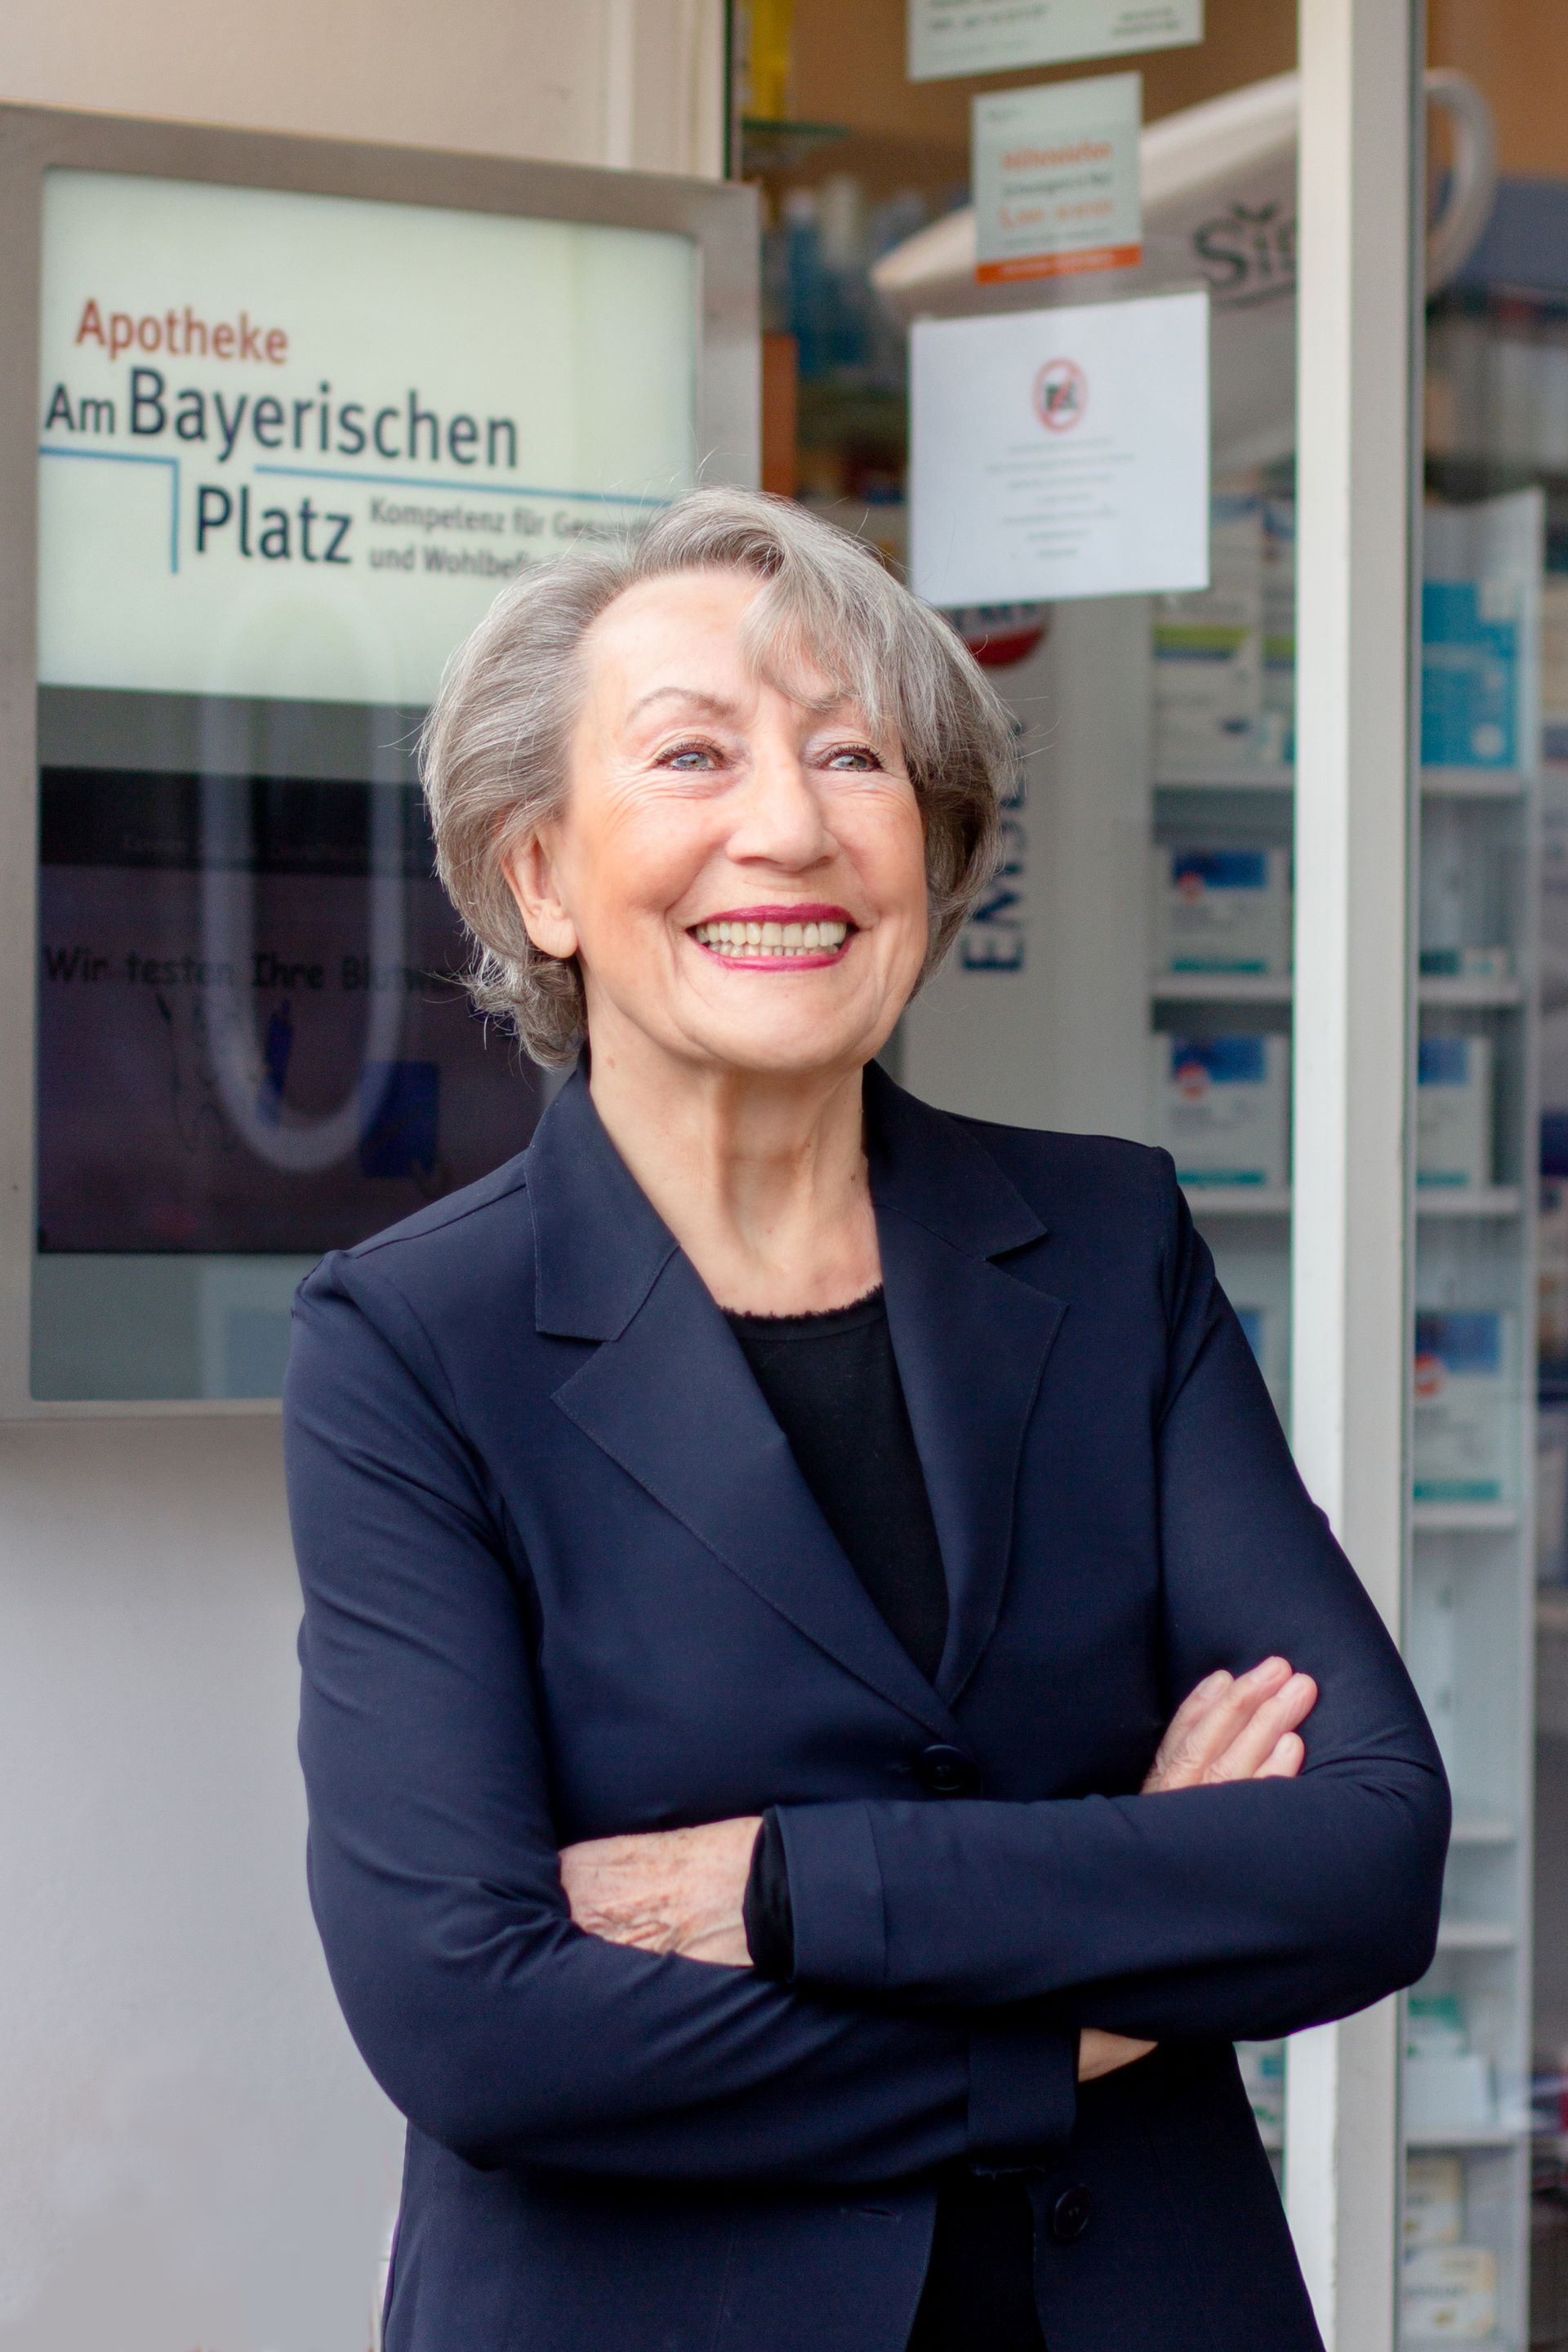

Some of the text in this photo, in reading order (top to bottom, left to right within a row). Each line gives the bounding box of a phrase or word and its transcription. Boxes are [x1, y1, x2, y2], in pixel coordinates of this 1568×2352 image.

[74, 297, 289, 365] Apotheke
[44, 365, 519, 470] Am Bayerischen
[194, 483, 354, 565] Platz
[370, 497, 506, 536] Kompetenz
[512, 506, 544, 537] für
[369, 542, 415, 572] und
[43, 945, 109, 983] Wir
[251, 951, 324, 991] Ihre
